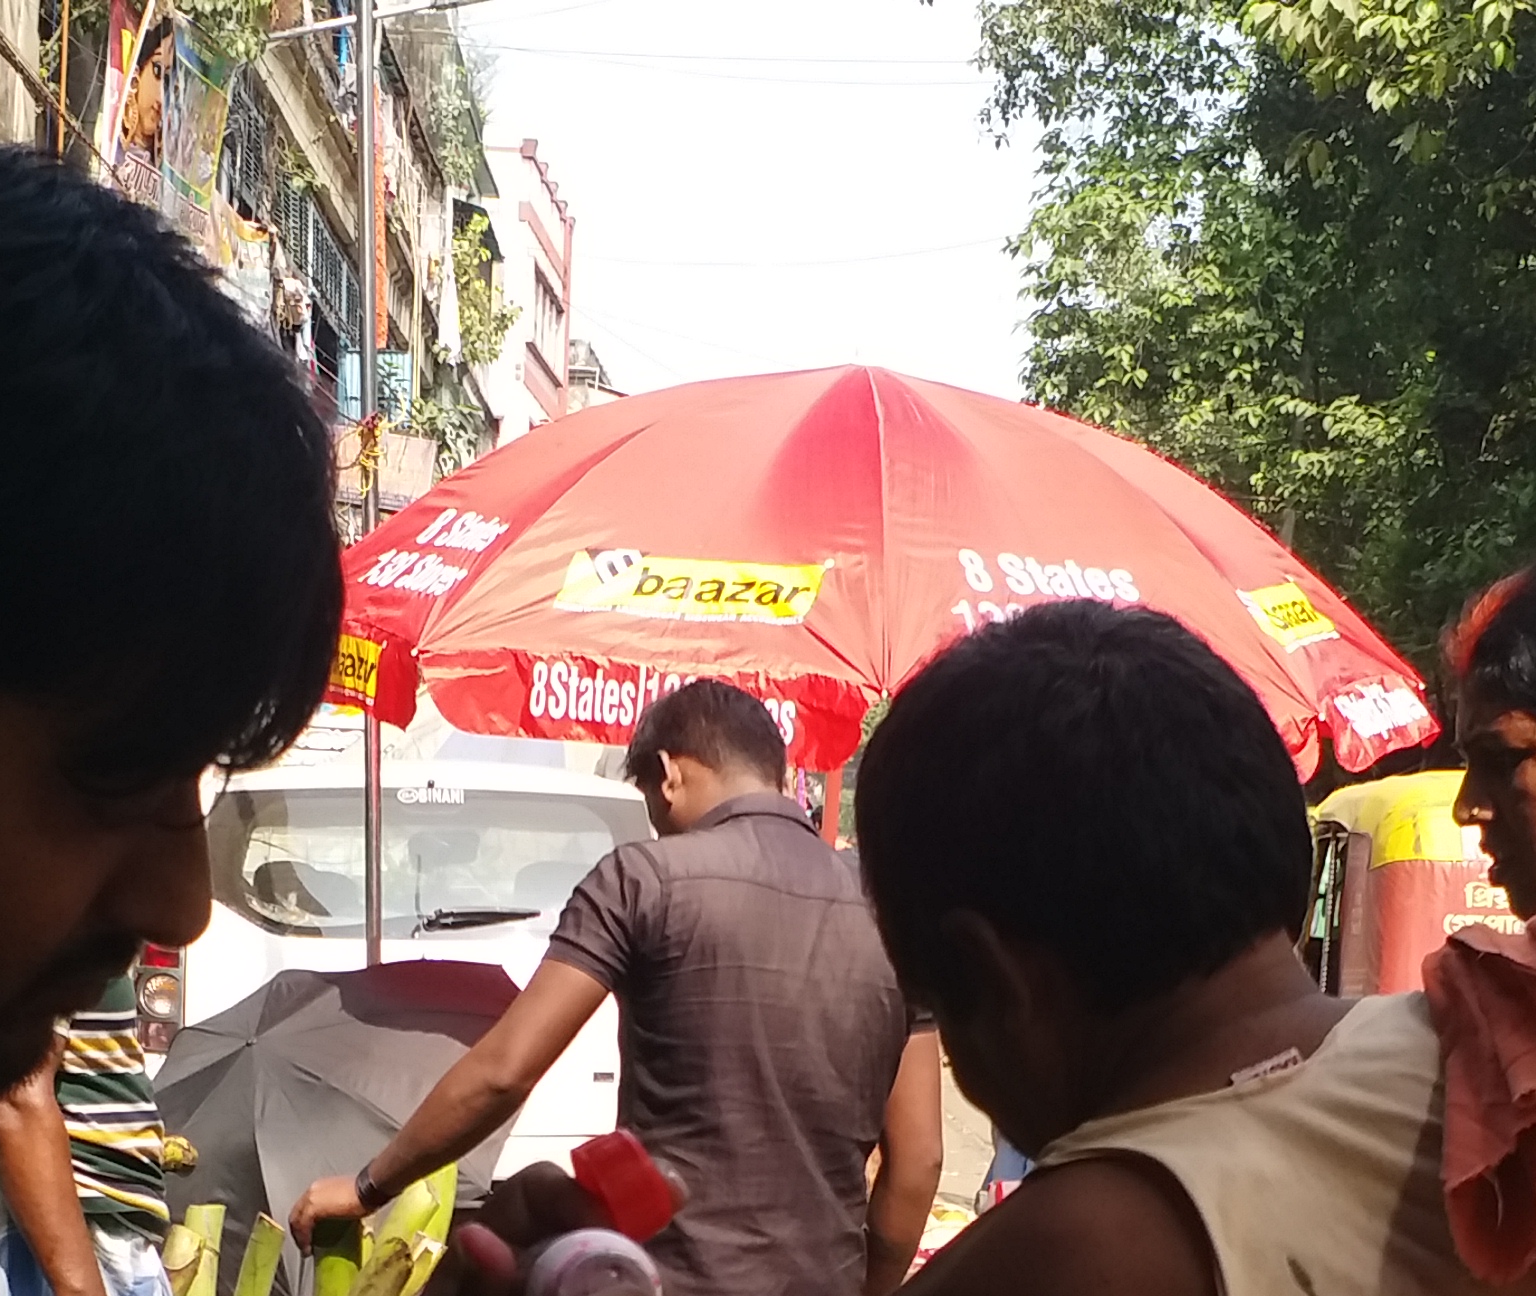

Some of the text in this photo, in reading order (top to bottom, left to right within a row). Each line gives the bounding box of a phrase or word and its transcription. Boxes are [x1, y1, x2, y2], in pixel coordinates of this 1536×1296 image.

[416, 508, 510, 552] 8 States
[632, 567, 811, 606] baazar
[958, 547, 1140, 602] 8 States
[418, 788, 465, 805] BINANI
